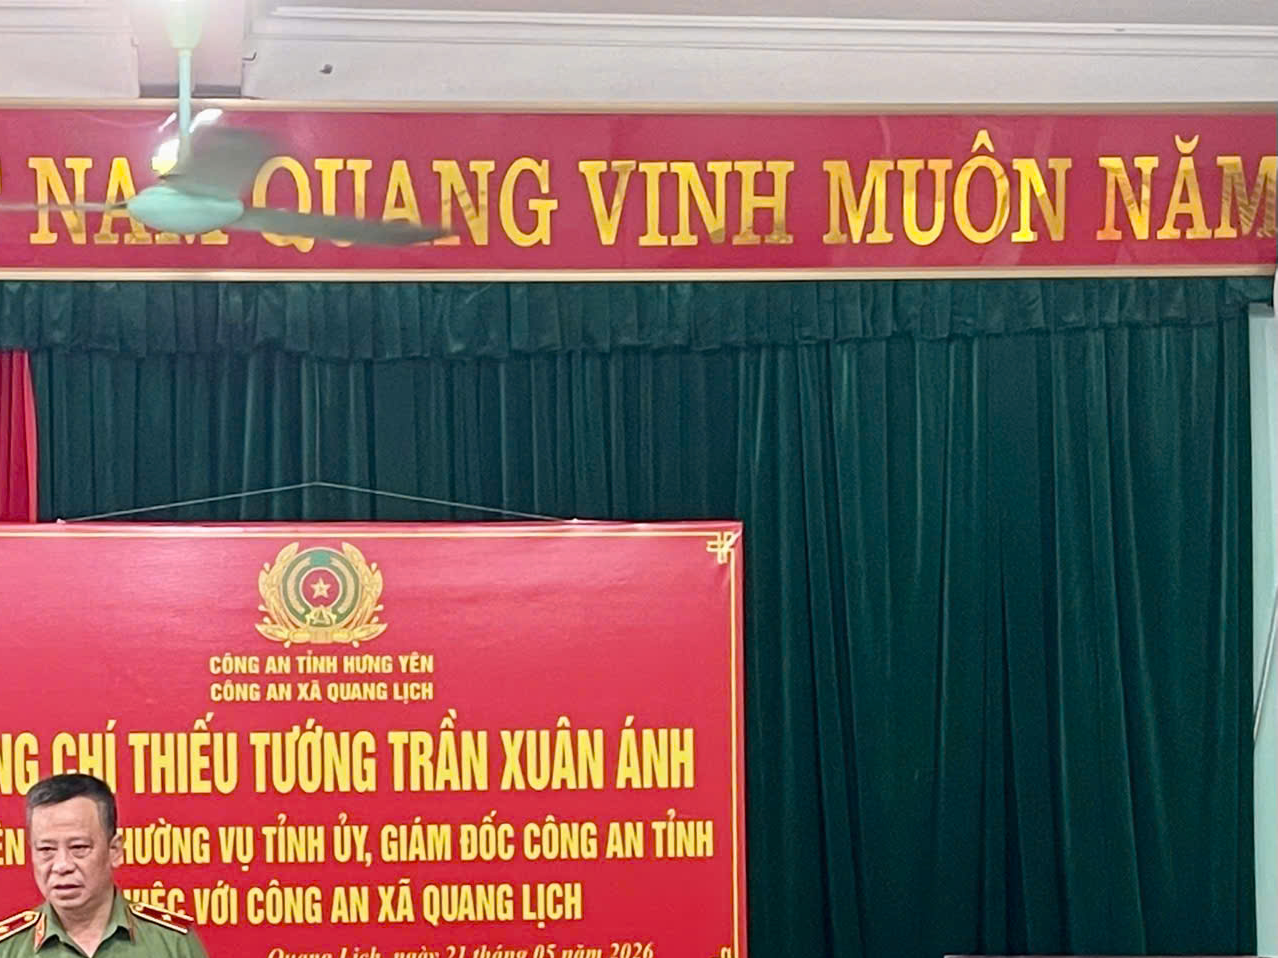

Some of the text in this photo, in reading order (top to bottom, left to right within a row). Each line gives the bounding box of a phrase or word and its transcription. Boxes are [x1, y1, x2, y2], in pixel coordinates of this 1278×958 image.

[28, 157, 229, 245] NA
[578, 160, 794, 247] VINH
[823, 129, 1071, 247] MUÔN
[1096, 134, 1278, 241] NĂM
[210, 650, 434, 674] CÔNG AN TỈNH HƯNG YÊN
[210, 680, 434, 704] CÔNG AN XÃ QUANG LỊCH
[51, 719, 117, 794] CHÍ
[128, 712, 238, 794] THIẾU
[250, 718, 377, 793] TƯỚNG
[388, 709, 489, 791] TRẦN
[500, 716, 605, 791] XUÂN
[616, 715, 695, 789] ÁNH
[218, 826, 254, 873] VỤ
[261, 813, 325, 864] TỈNH
[332, 812, 373, 868] ỦY,
[379, 816, 453, 862] GIÁM
[459, 810, 516, 862] ĐỐC
[522, 814, 599, 860] CÔNG
[605, 820, 645, 860] AN
[651, 808, 715, 859] TỈNH
[193, 879, 238, 925] VỚI
[246, 880, 323, 926] CÔNG
[330, 886, 370, 924] AN
[377, 878, 416, 923] XÃ
[422, 883, 514, 927] QUANG
[521, 883, 583, 929] LỊCH
